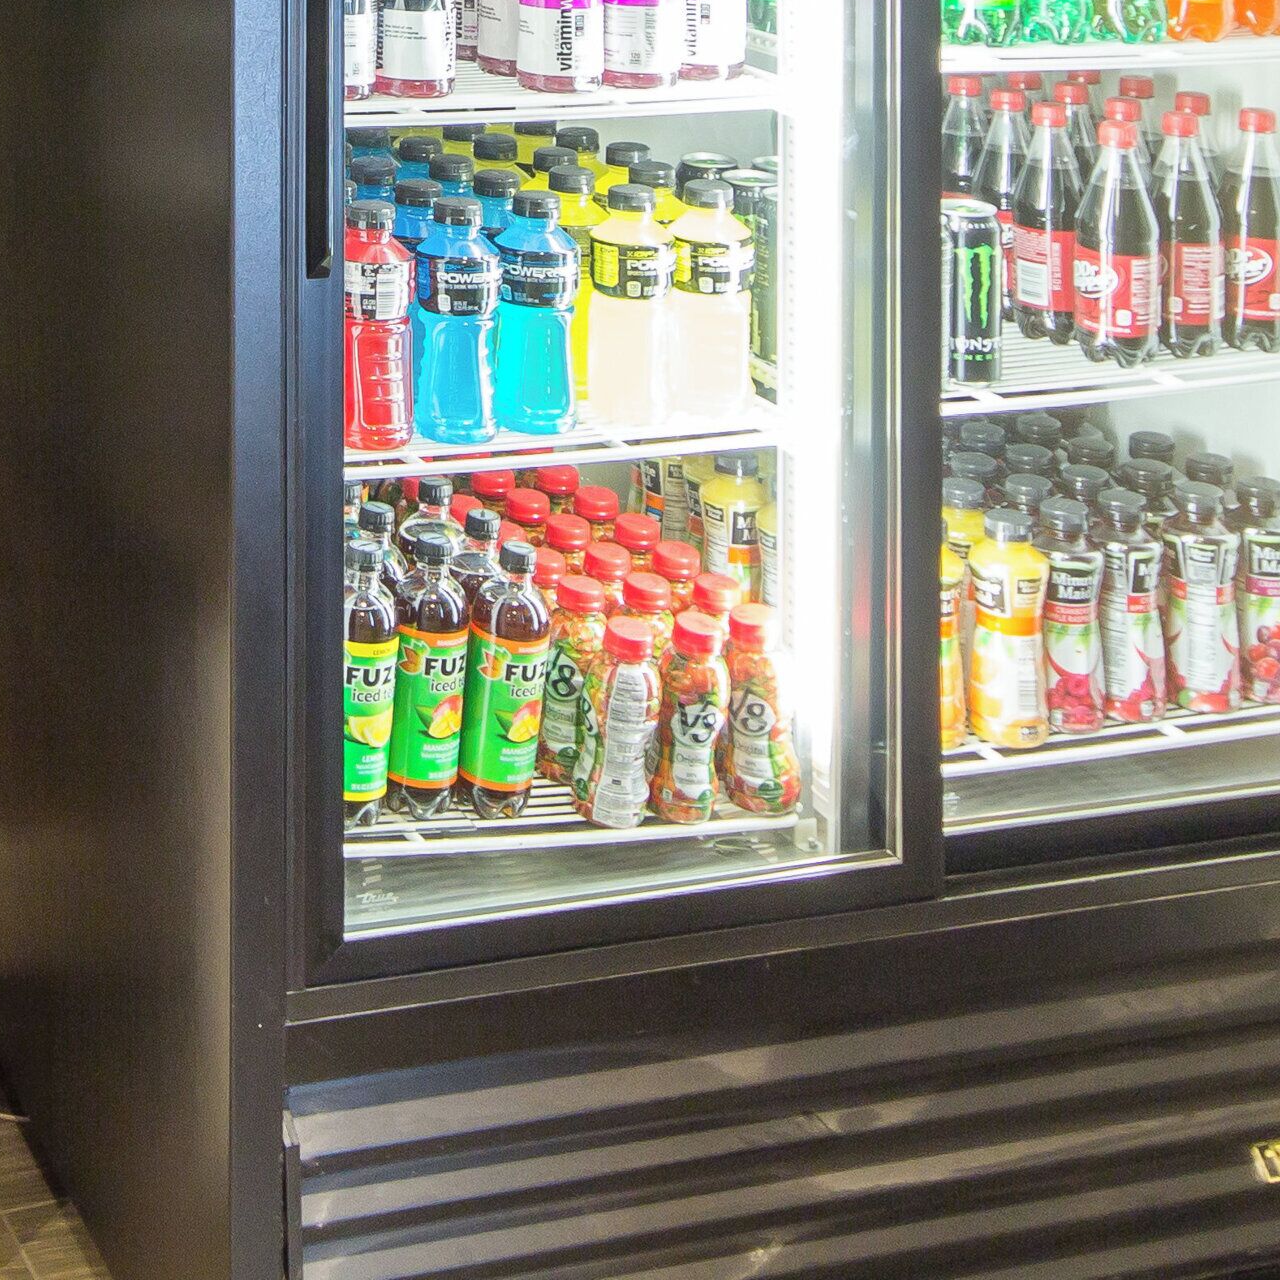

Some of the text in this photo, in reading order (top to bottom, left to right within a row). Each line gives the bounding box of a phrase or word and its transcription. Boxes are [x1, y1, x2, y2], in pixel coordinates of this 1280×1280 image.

[430, 678, 458, 692] iced
[510, 684, 537, 697] iced
[351, 689, 380, 702] iced
